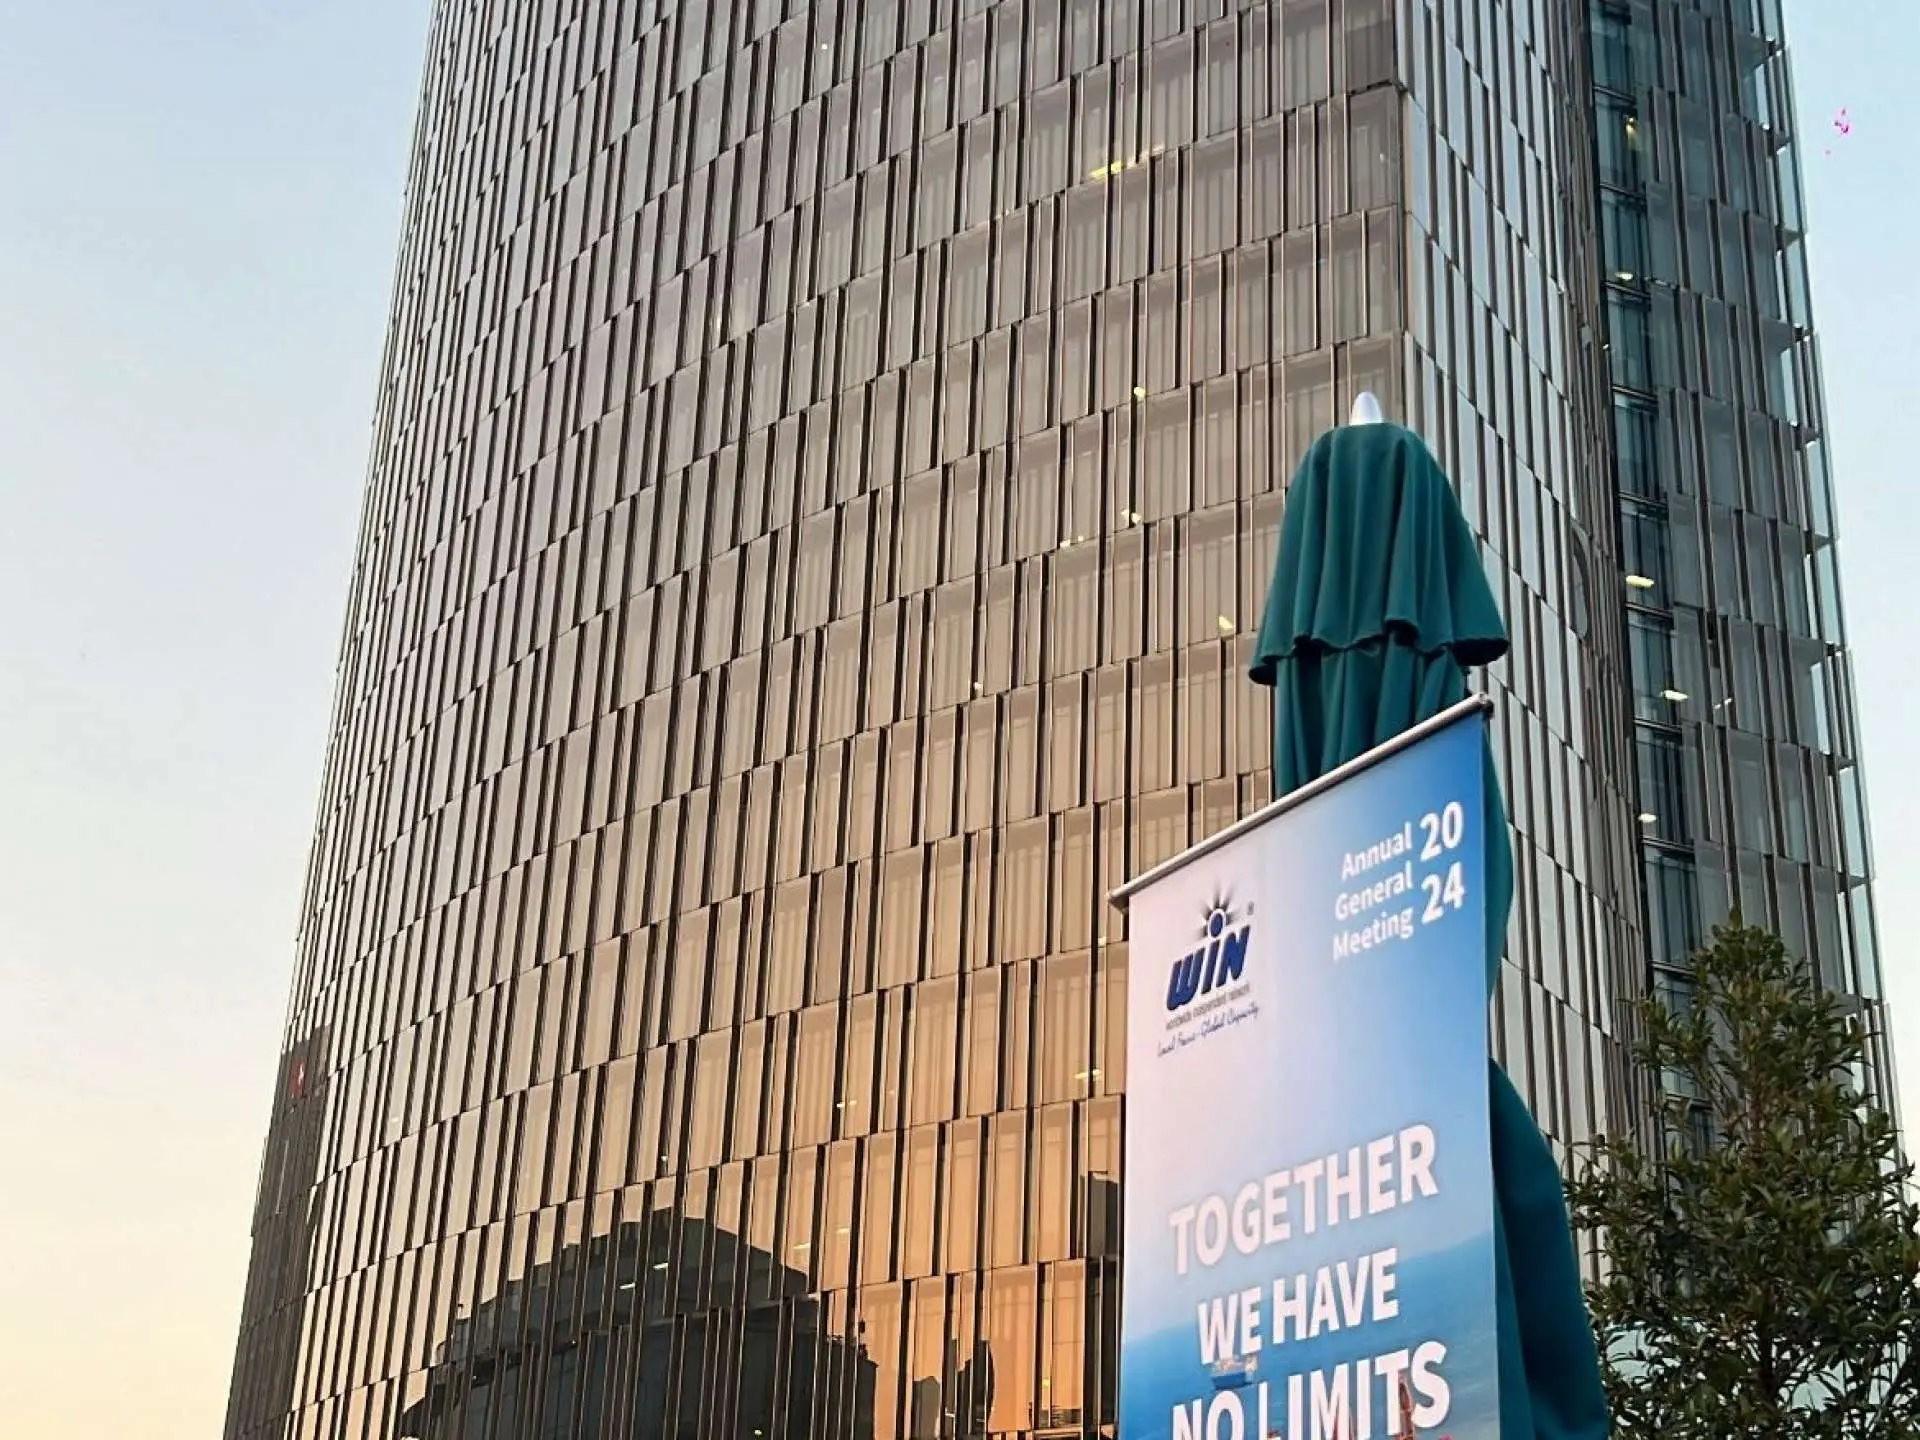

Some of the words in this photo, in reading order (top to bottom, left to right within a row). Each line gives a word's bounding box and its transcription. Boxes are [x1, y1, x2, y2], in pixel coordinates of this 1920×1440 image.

[1341, 820, 1412, 882] Annual
[1419, 801, 1464, 862] 20
[1334, 860, 1413, 922] General
[1420, 861, 1465, 925] 24
[1332, 906, 1414, 963] Meeting
[1169, 1124, 1439, 1276] TOGETHER
[1198, 1286, 1263, 1365] WE
[1272, 1247, 1400, 1344] HAVE
[1172, 1390, 1245, 1440] NO
[1258, 1340, 1451, 1440] LIMITS
